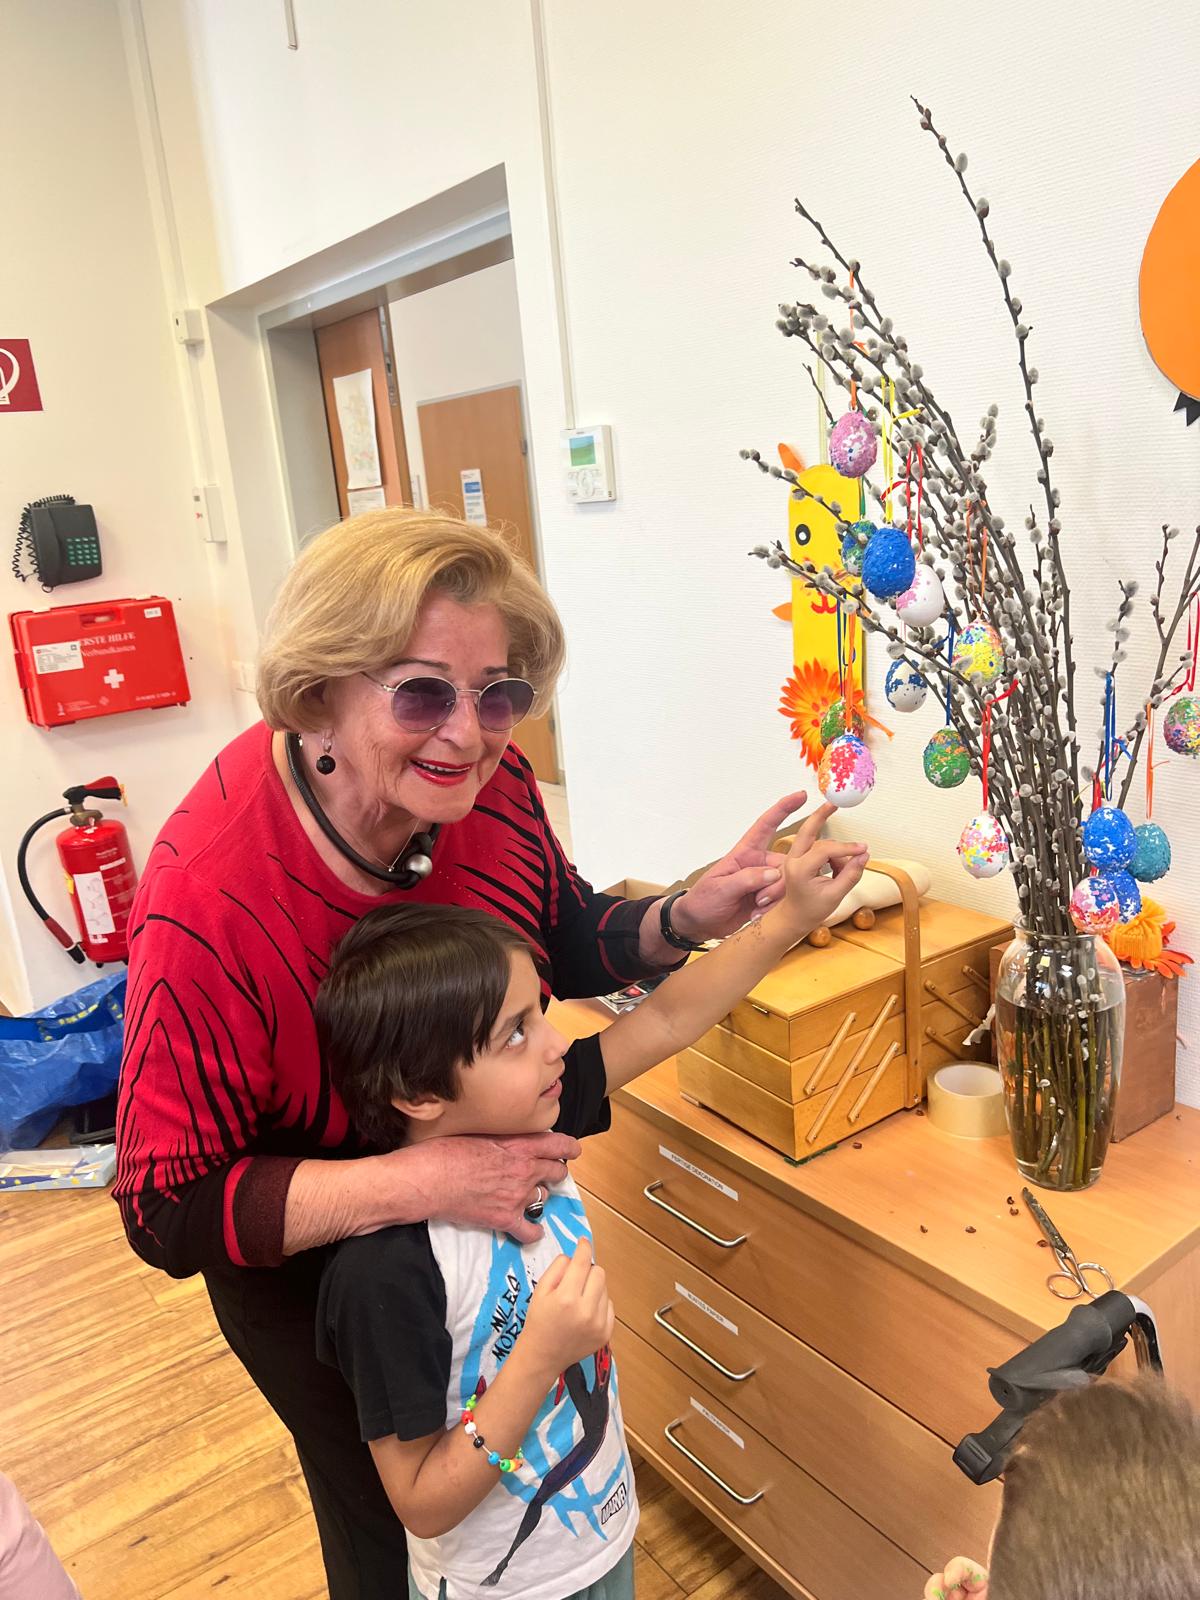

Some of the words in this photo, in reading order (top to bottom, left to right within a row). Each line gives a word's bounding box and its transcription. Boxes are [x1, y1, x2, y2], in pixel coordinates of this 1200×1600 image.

[107, 631, 135, 643] HILFE
[490, 1274, 521, 1333] MILES
[491, 1279, 538, 1364] MORA
